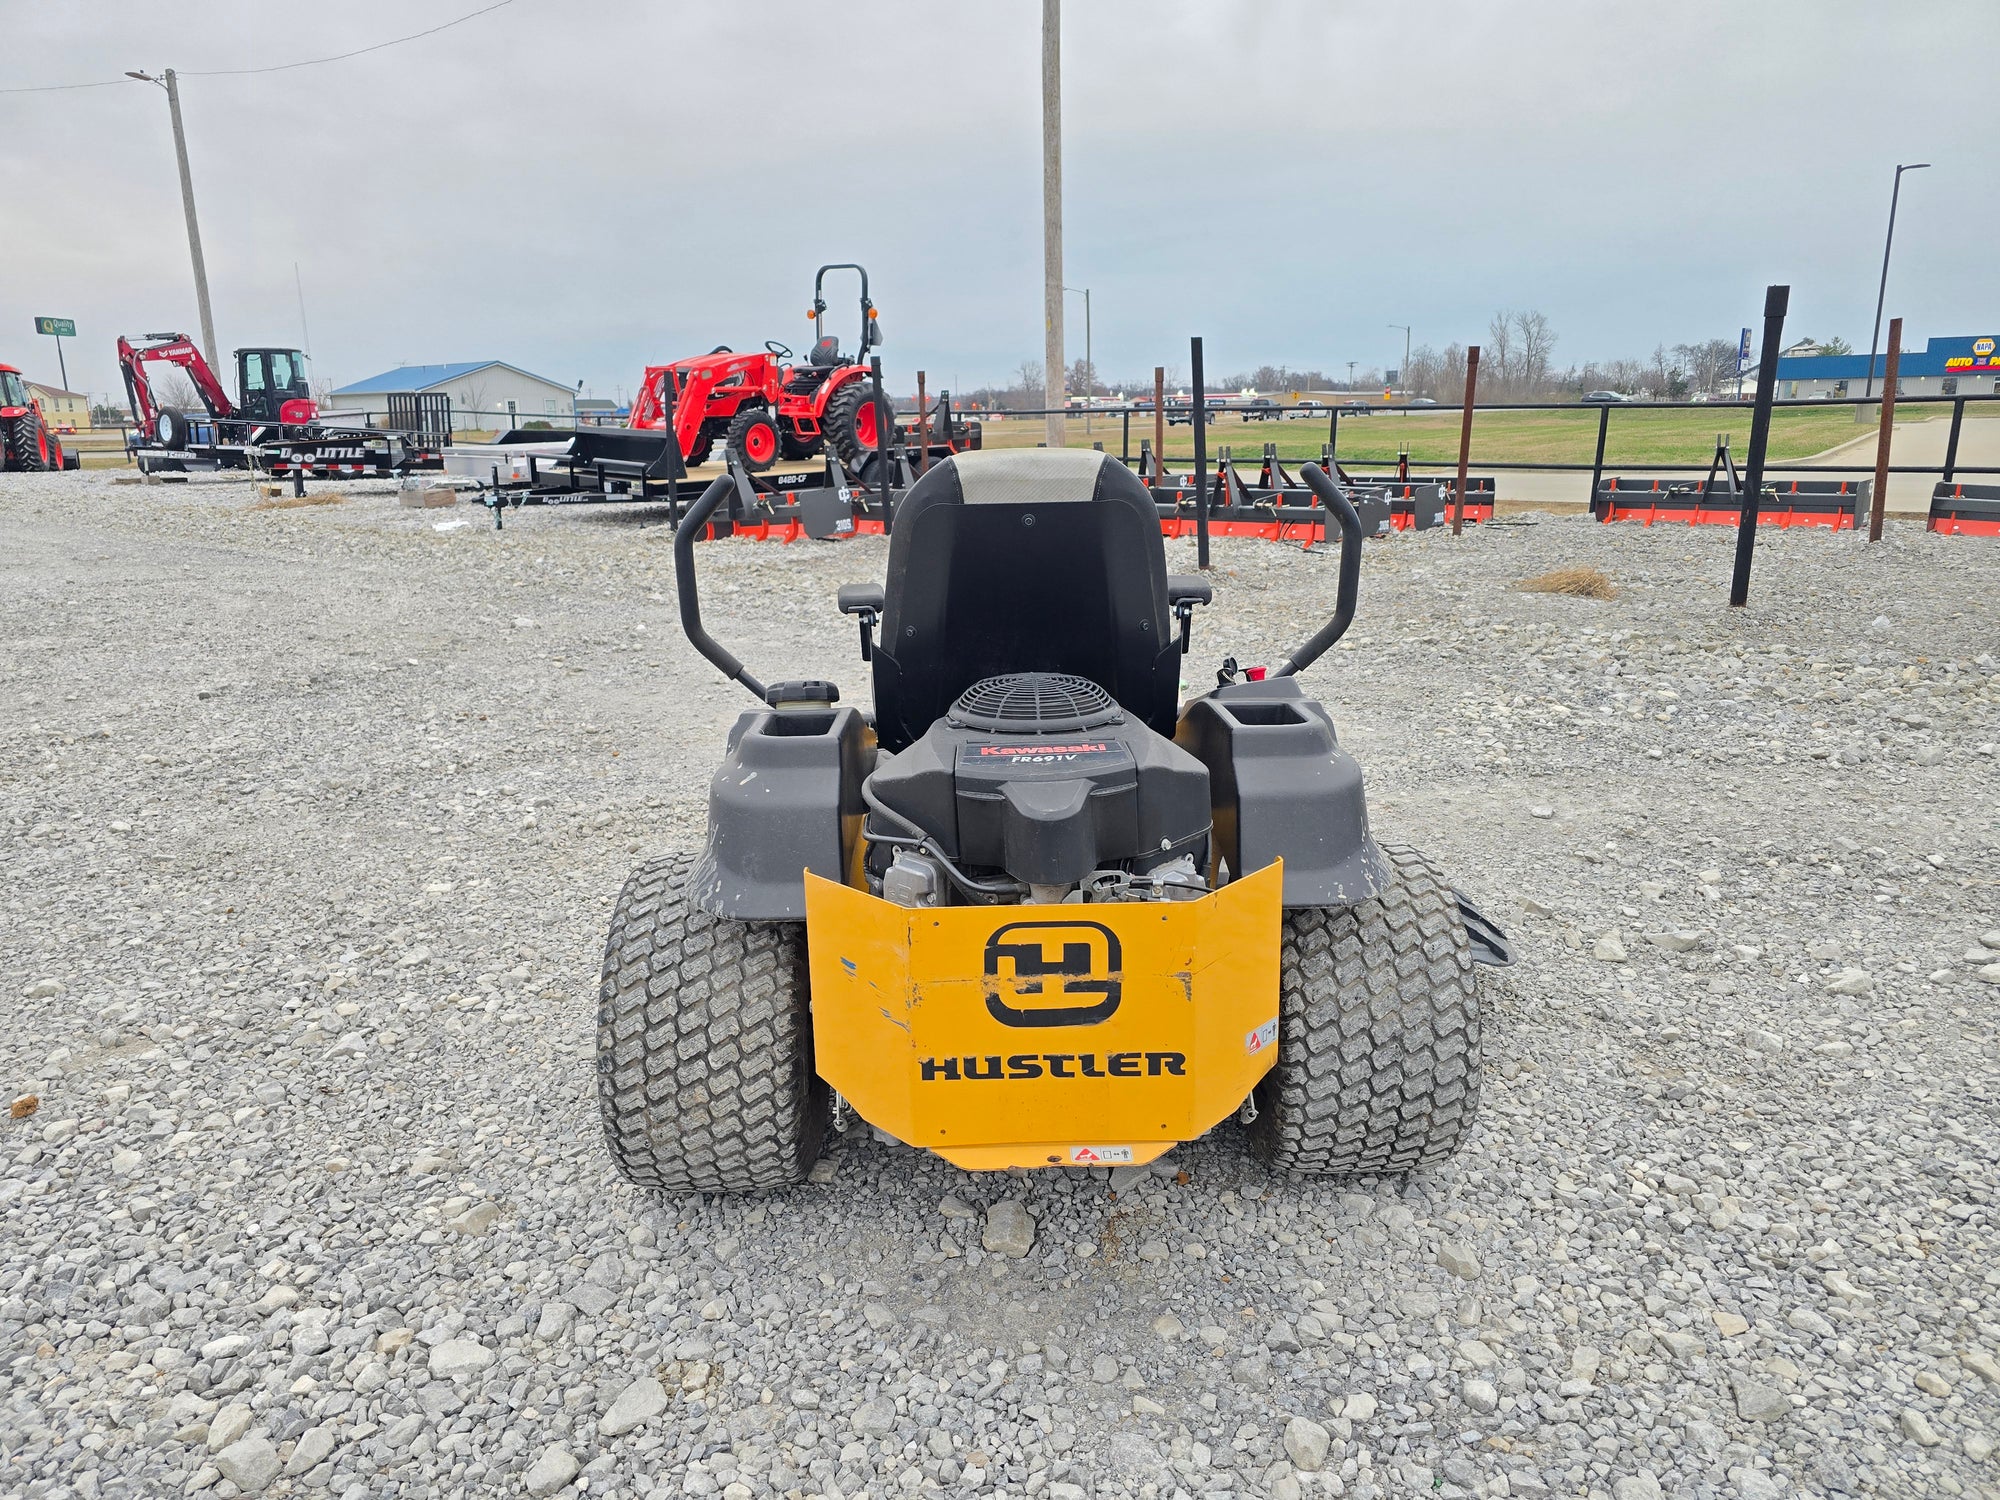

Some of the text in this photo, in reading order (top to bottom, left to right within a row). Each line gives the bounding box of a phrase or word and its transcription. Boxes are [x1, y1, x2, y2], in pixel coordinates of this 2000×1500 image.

[53, 319, 73, 330] Quality
[168, 346, 192, 356] YANMAR
[1976, 343, 1992, 351] NAPA
[1945, 357, 1973, 367] AUTO
[980, 743, 1107, 756] Kawasaki
[1011, 754, 1077, 763] FR691V
[919, 1052, 1187, 1081] HUSTLER
